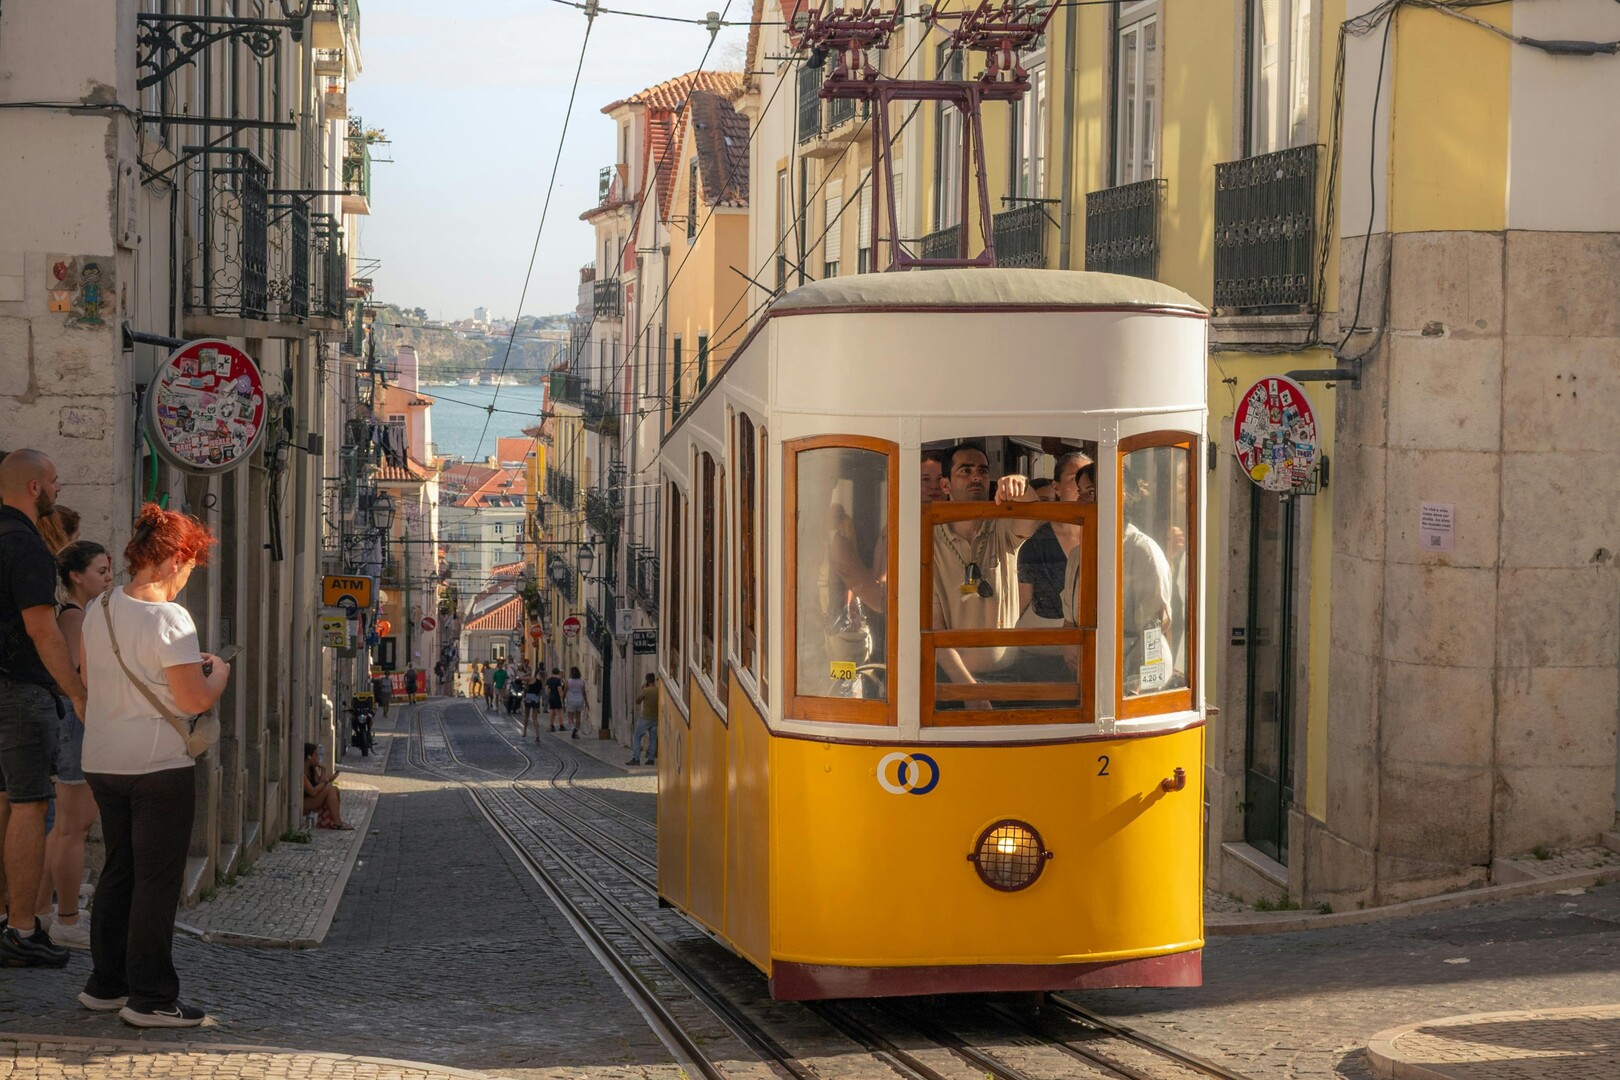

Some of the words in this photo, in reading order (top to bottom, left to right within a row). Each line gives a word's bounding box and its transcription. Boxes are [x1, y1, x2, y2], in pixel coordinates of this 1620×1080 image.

[332, 579, 363, 590] ATM
[830, 669, 852, 680] 4.20
[1142, 674, 1157, 683] 4.20
[1097, 755, 1110, 777] 2
